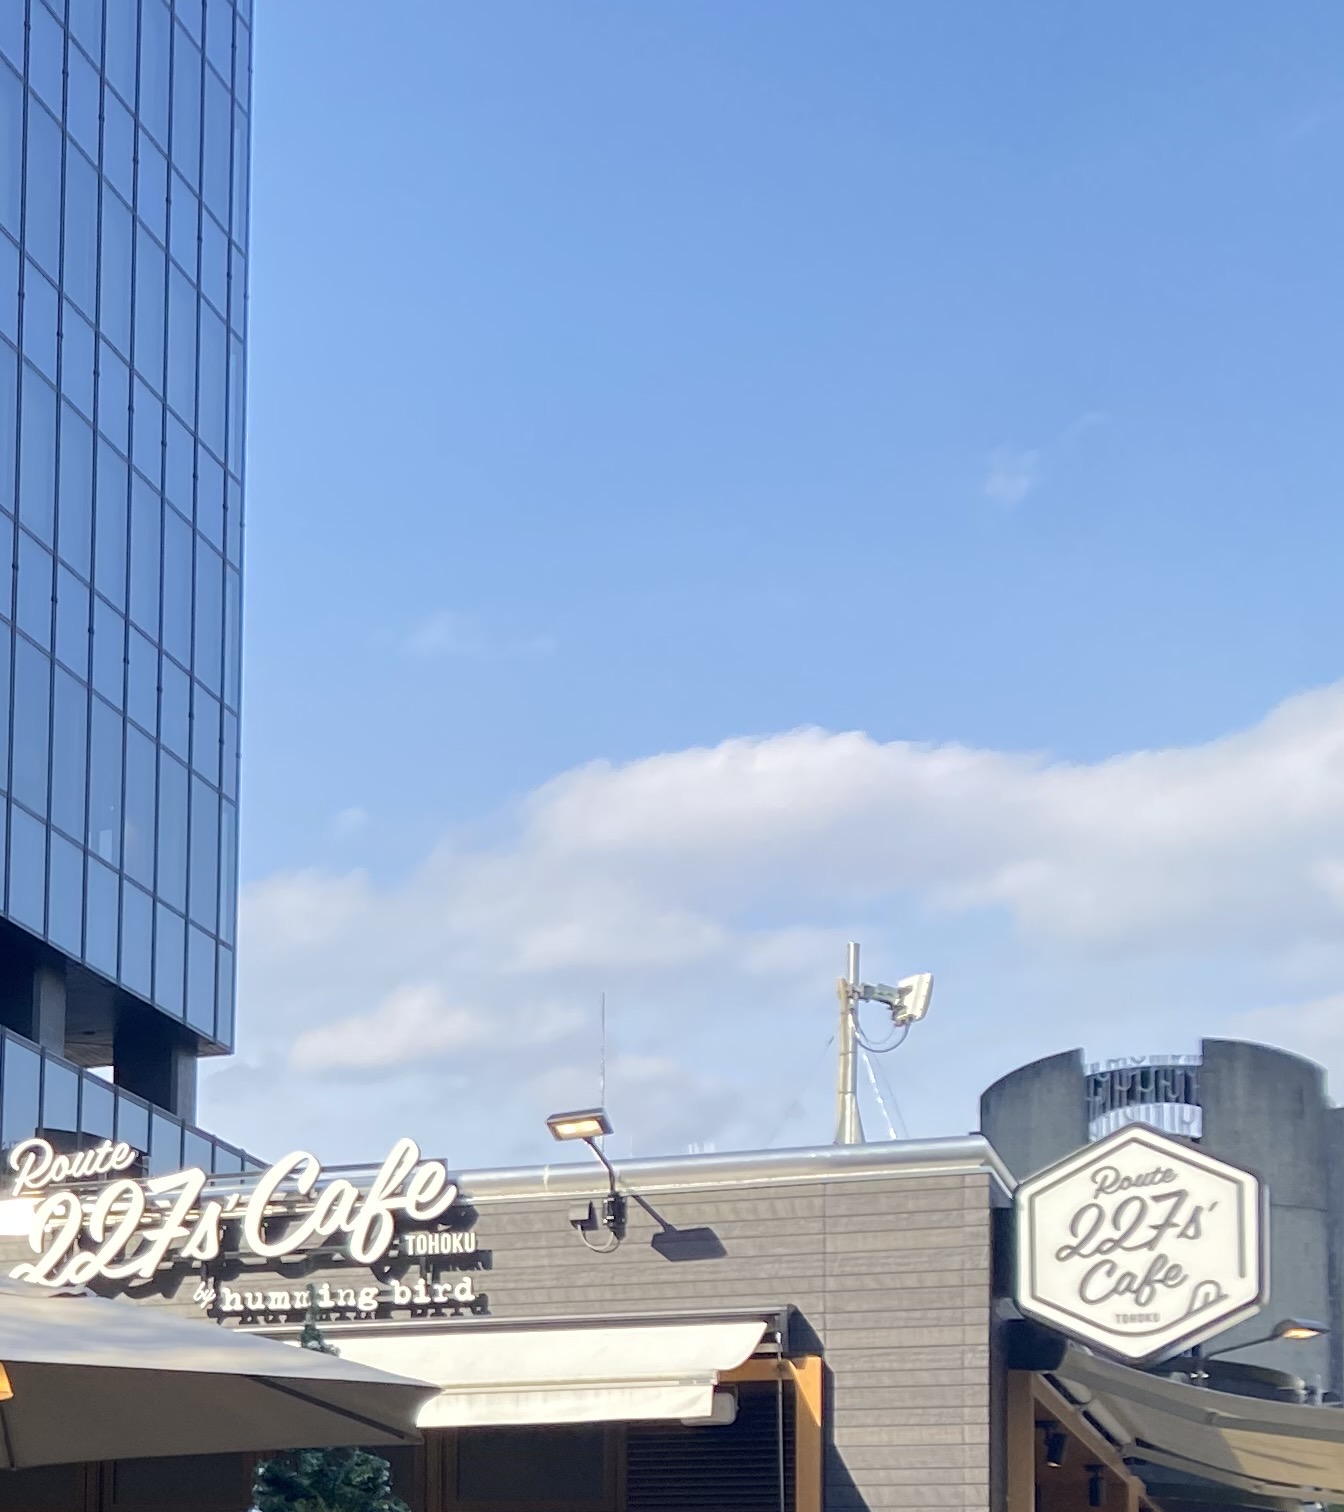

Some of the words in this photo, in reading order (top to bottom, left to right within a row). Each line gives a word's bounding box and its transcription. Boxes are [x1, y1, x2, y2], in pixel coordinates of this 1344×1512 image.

[9, 1138, 136, 1197] Route
[1091, 1165, 1178, 1199] Route
[243, 1137, 458, 1264] Cafe
[405, 1233, 478, 1256] TOHOKU
[193, 1281, 216, 1310] by
[221, 1281, 380, 1312] humming
[391, 1278, 477, 1306] bird
[1079, 1253, 1189, 1306] Cafe
[1115, 1312, 1160, 1323] TOHOKU
